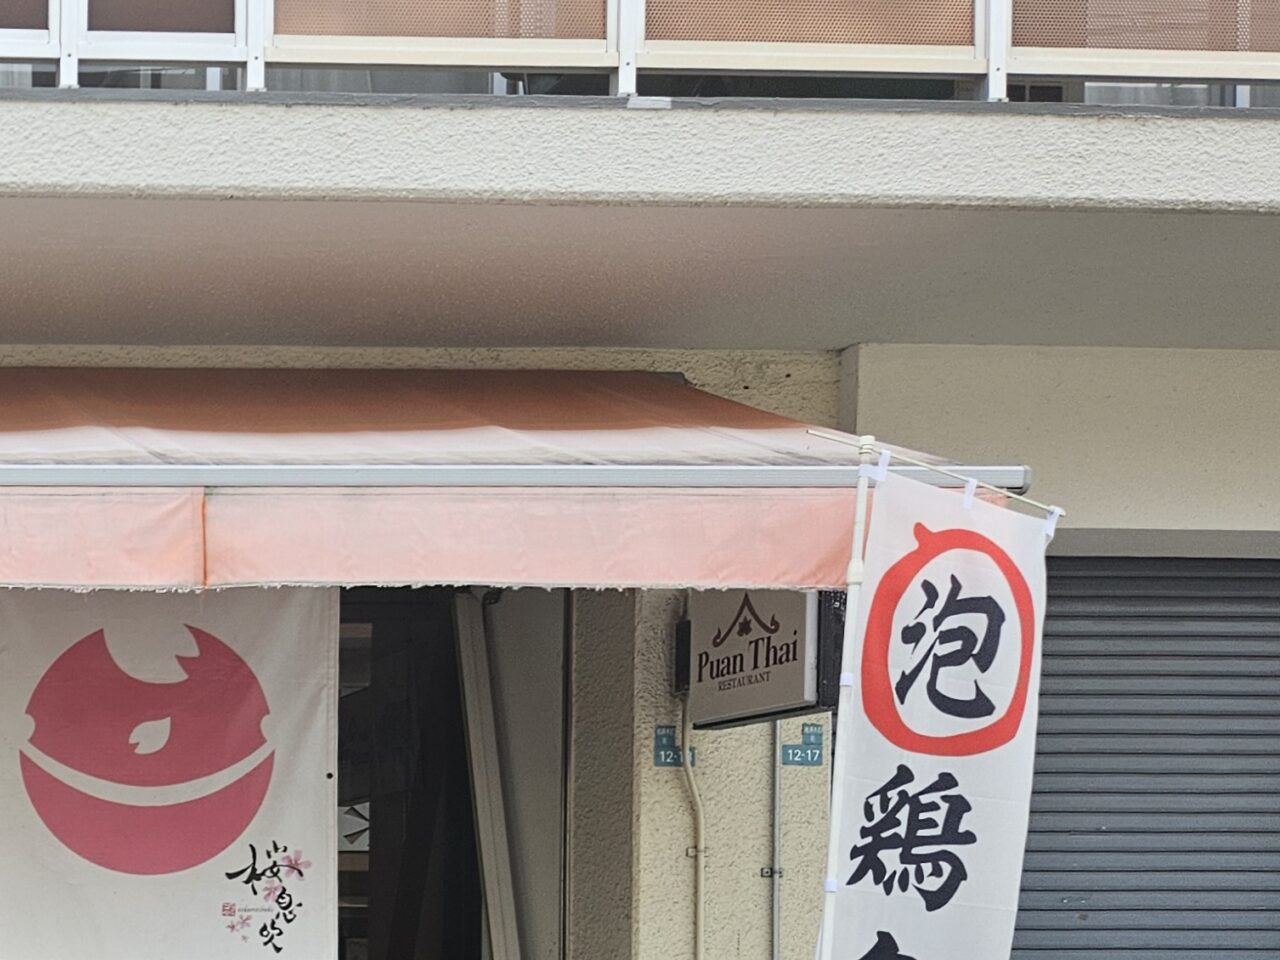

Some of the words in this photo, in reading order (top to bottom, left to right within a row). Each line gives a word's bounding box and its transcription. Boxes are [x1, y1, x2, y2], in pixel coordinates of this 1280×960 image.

[697, 651, 744, 683] Puan
[748, 629, 798, 670] Thai
[718, 671, 771, 692] RESTAURANT
[787, 749, 820, 762] 12-17
